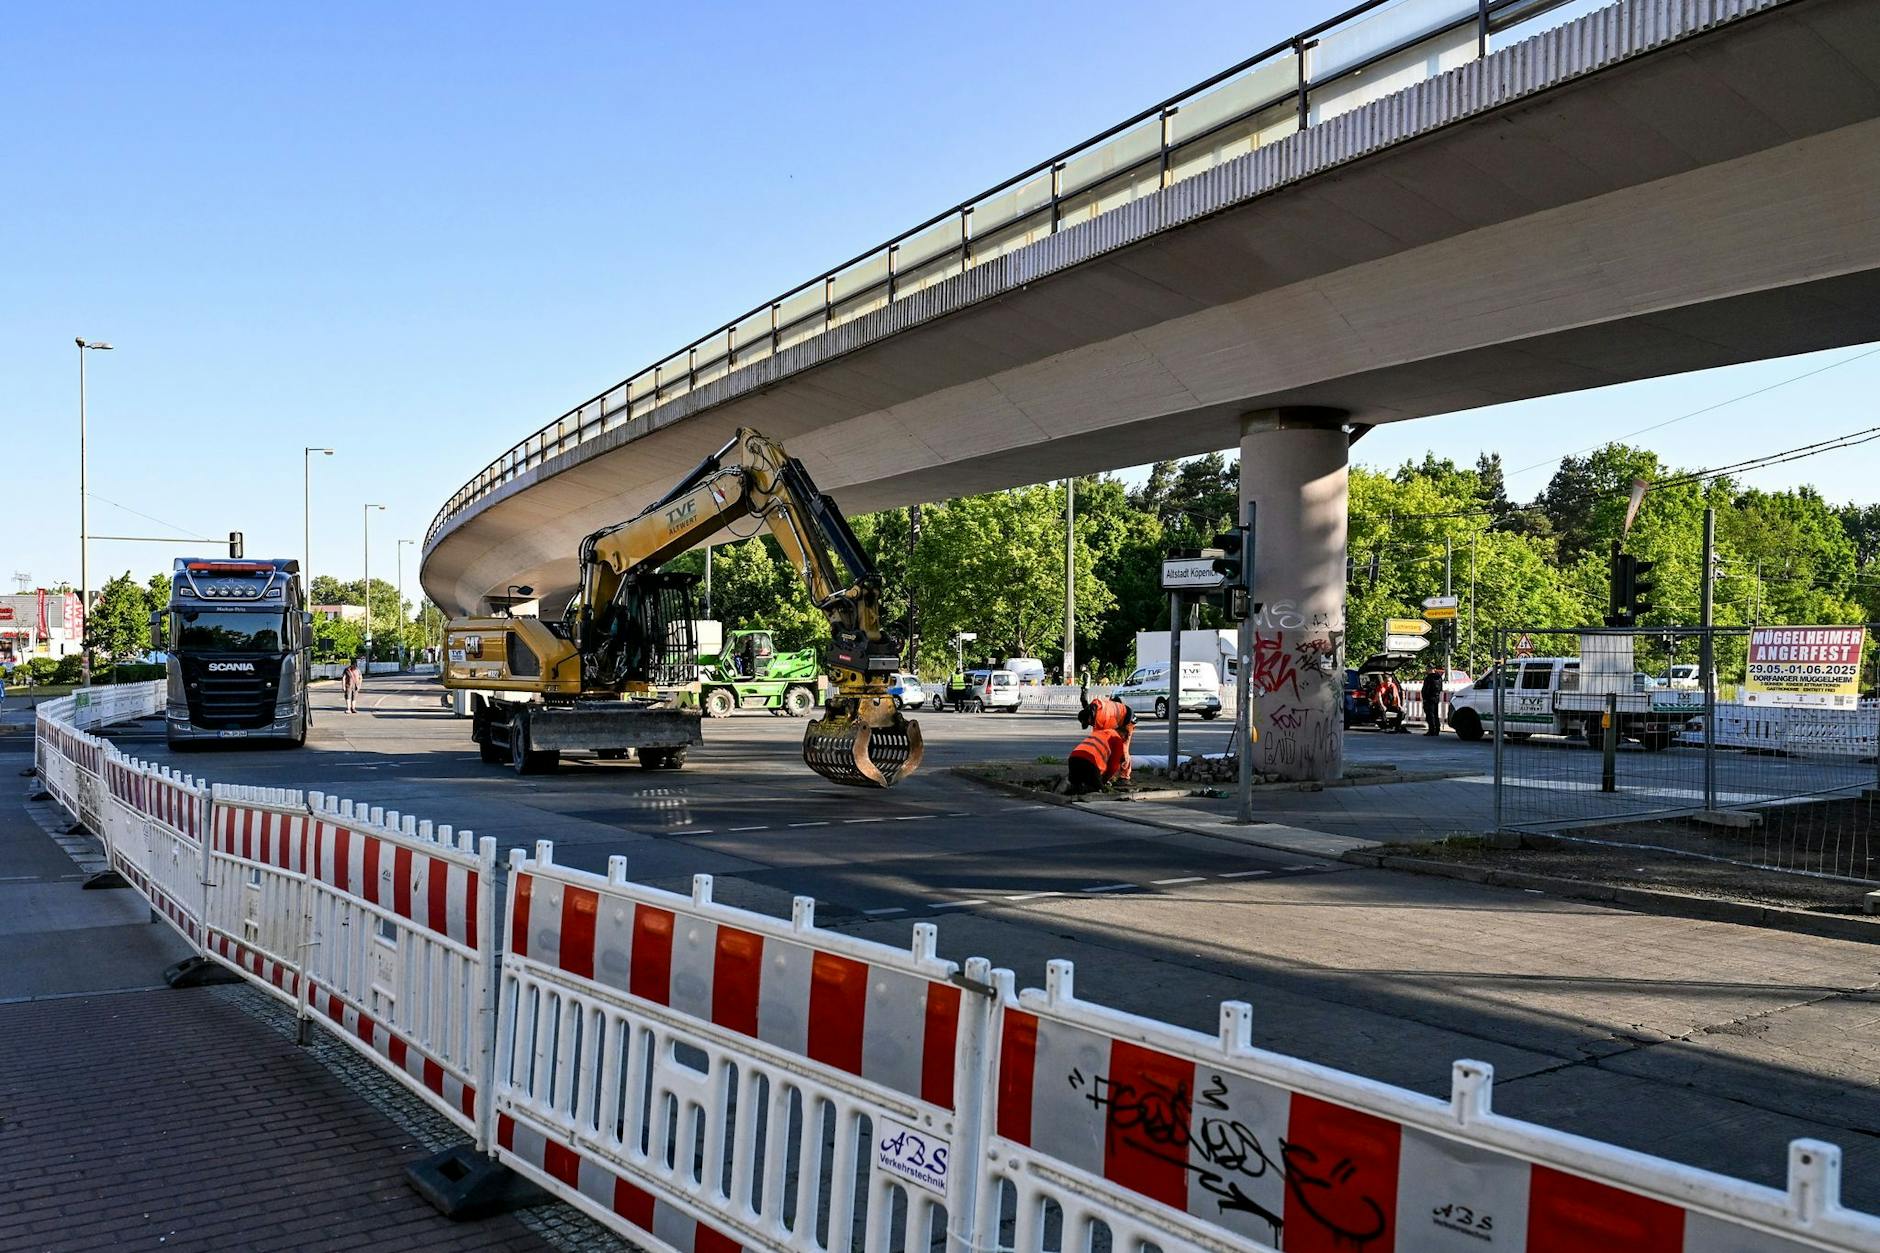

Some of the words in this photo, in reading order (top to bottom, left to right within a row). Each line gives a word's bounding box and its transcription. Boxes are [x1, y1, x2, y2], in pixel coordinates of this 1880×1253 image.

[665, 498, 695, 523] TVF
[669, 515, 697, 536] ALTWERT
[1167, 568, 1189, 579] Altstadt
[465, 636, 479, 653] CAT
[1752, 630, 1861, 645] MÜGGELHEIMER
[1757, 645, 1852, 661] ANGERFEST
[208, 662, 254, 672] SCANIA
[1749, 664, 1857, 675] 29.05.-01.06.2025
[1753, 675, 1799, 683] DORFANGER
[1800, 675, 1853, 683] MÜGGELHEIM
[881, 1131, 948, 1176] ABS
[880, 1153, 946, 1190] Verkehrstechnik
[1432, 1203, 1493, 1231] ABS
